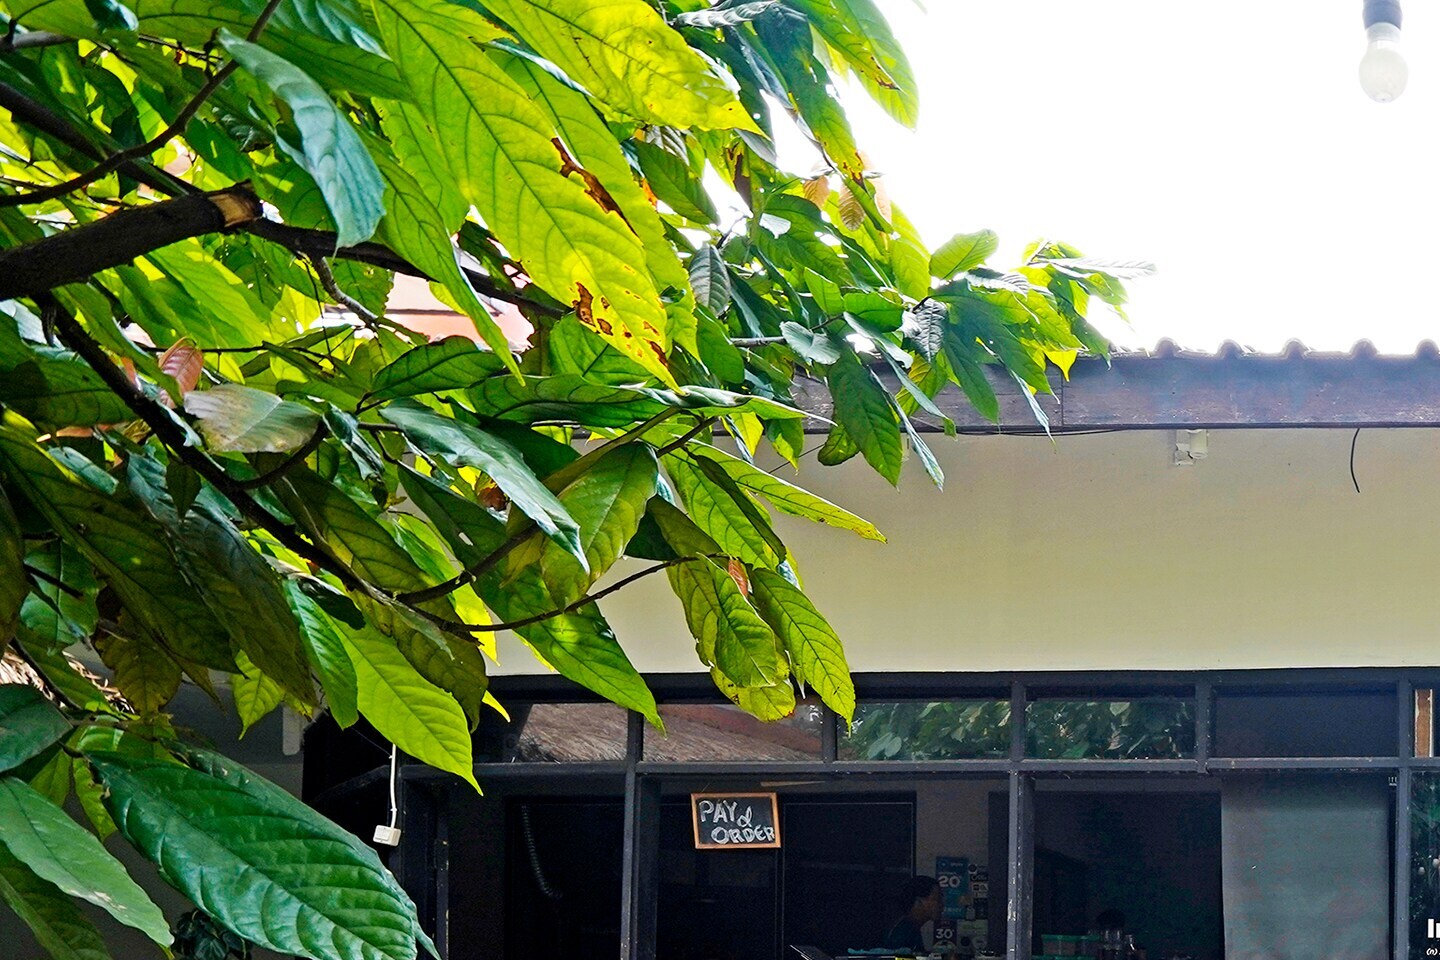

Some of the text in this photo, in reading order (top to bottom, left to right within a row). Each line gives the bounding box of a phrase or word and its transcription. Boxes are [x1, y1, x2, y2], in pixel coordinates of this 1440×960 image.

[699, 800, 737, 822] PAY
[711, 825, 775, 844] ORDER
[1426, 948, 1438, 956] (n)
